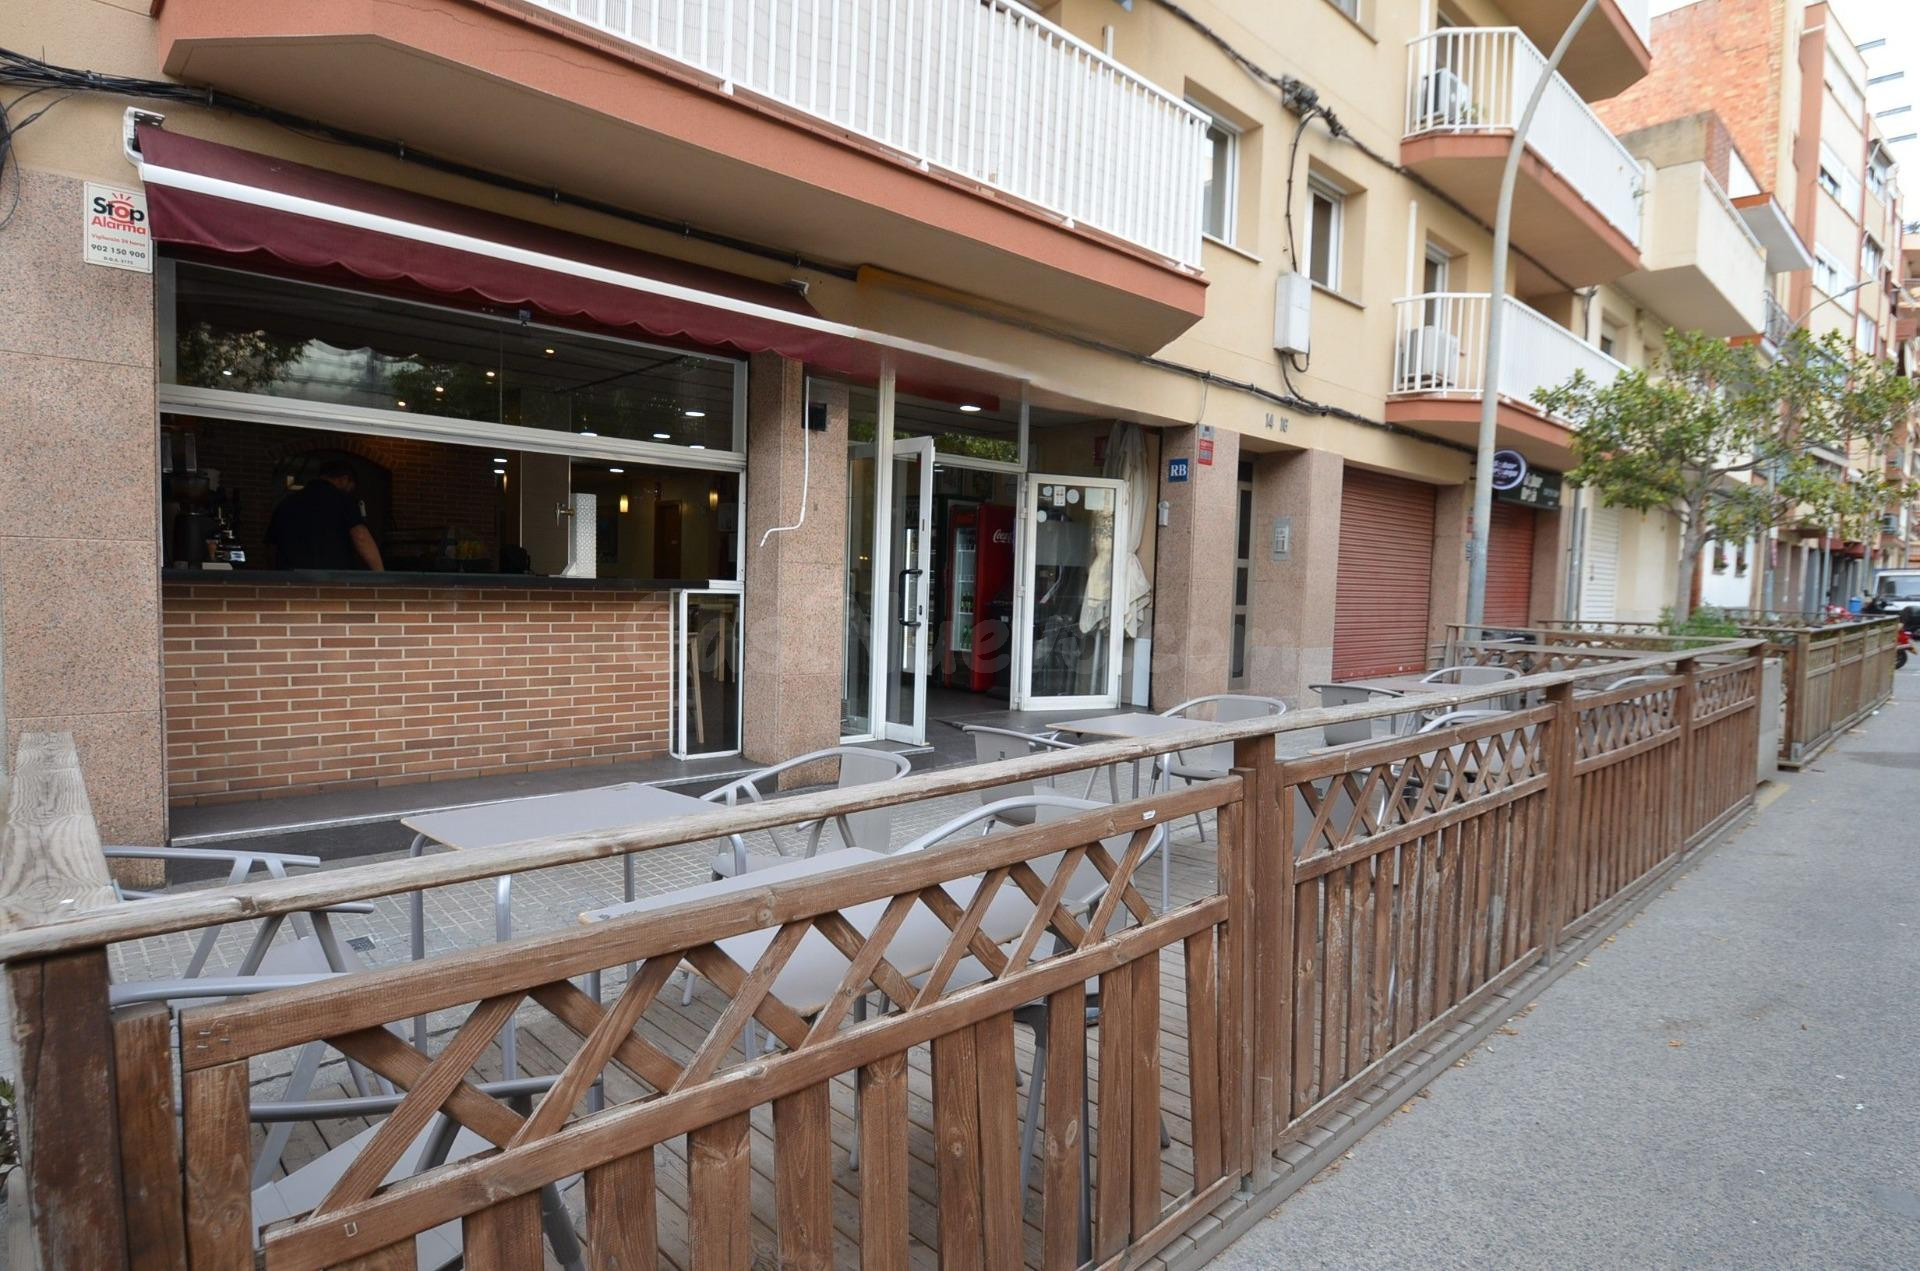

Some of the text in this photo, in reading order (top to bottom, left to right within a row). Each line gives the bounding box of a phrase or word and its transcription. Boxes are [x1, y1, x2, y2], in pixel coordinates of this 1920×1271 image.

[93, 196, 144, 224] Stop
[92, 216, 146, 234] Alarma
[91, 243, 145, 259] 902 150 900
[1170, 464, 1187, 477] RB
